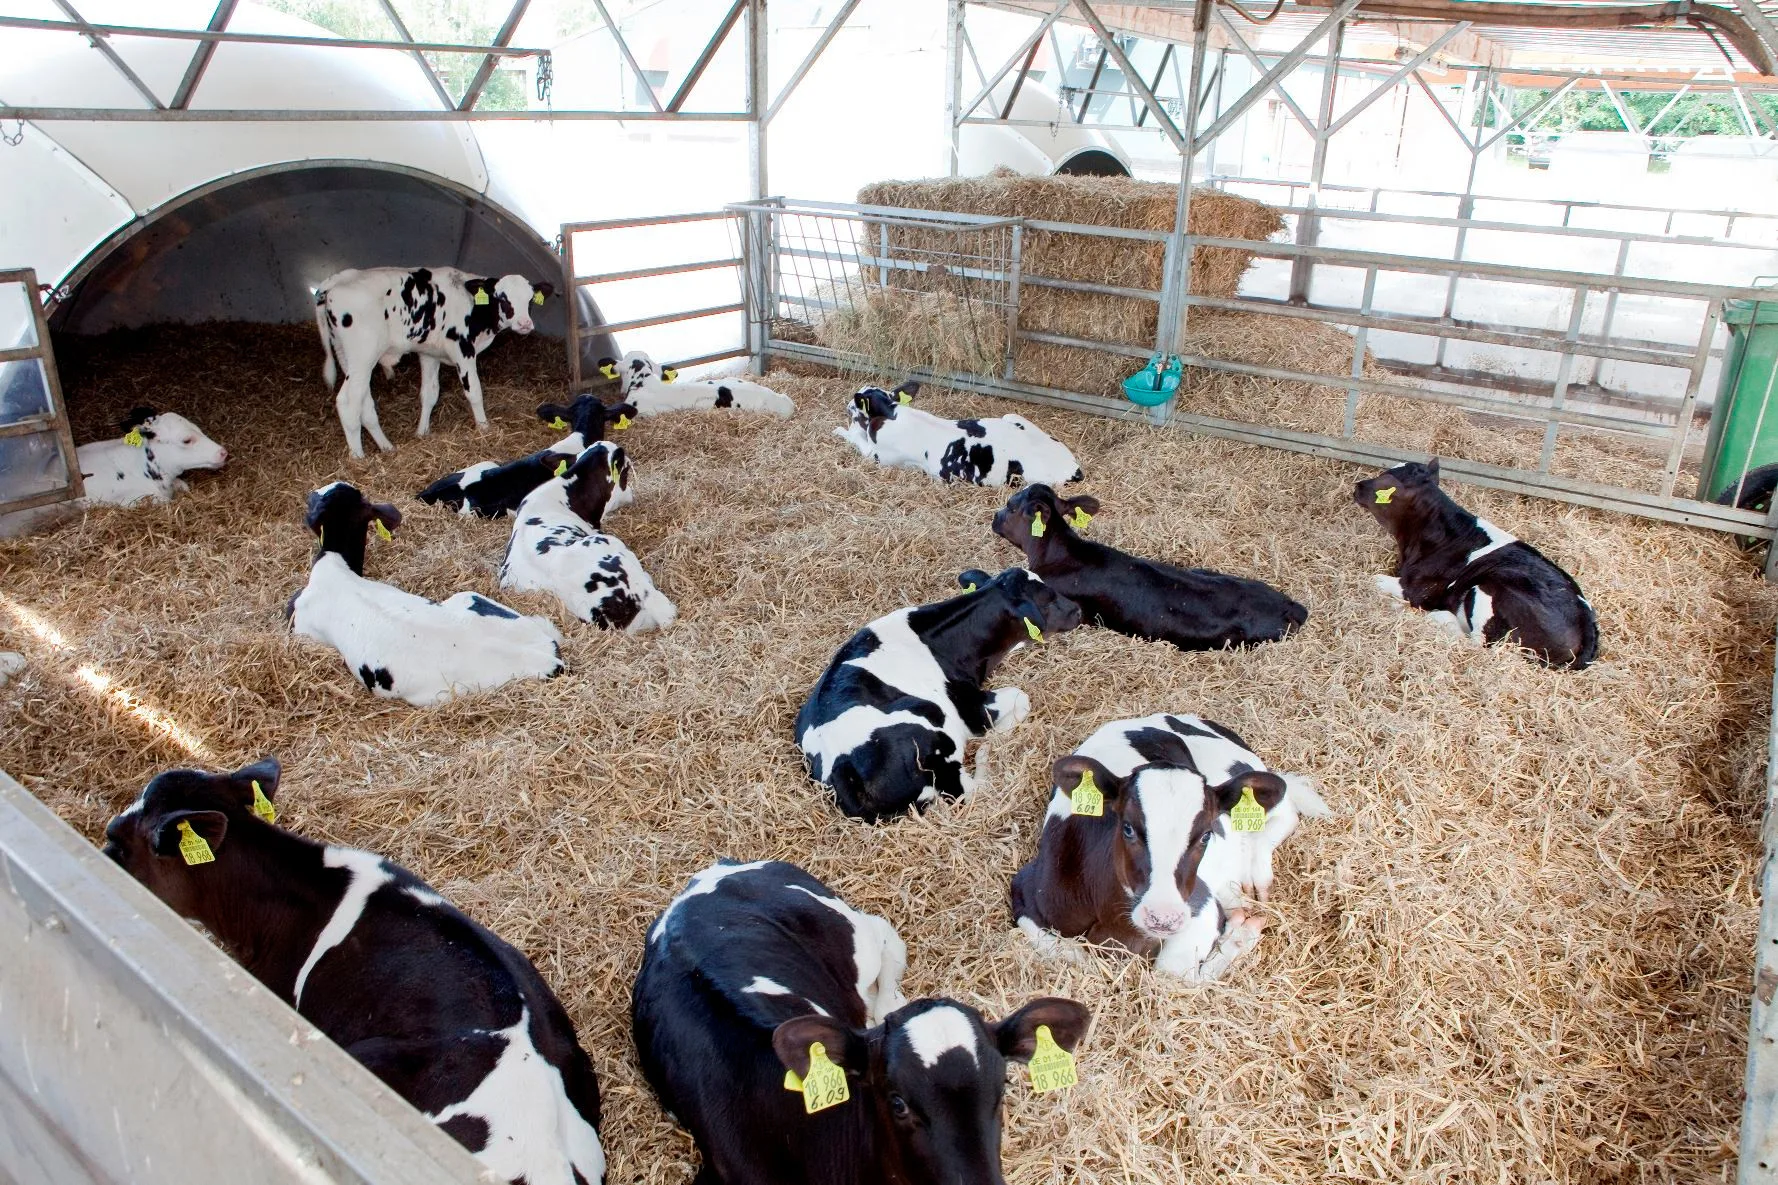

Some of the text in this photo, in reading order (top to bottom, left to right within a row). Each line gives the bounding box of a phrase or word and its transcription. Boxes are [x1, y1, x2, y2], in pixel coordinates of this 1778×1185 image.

[1073, 792, 1101, 805] 18 969
[1233, 819, 1264, 830] 18 969
[1032, 1057, 1041, 1065] DE
[1043, 1055, 1051, 1063] 01
[805, 1079, 819, 1097] 18
[823, 1069, 843, 1091] 966
[1034, 1068, 1074, 1090] 18 966
[811, 1087, 845, 1110] 6.09
